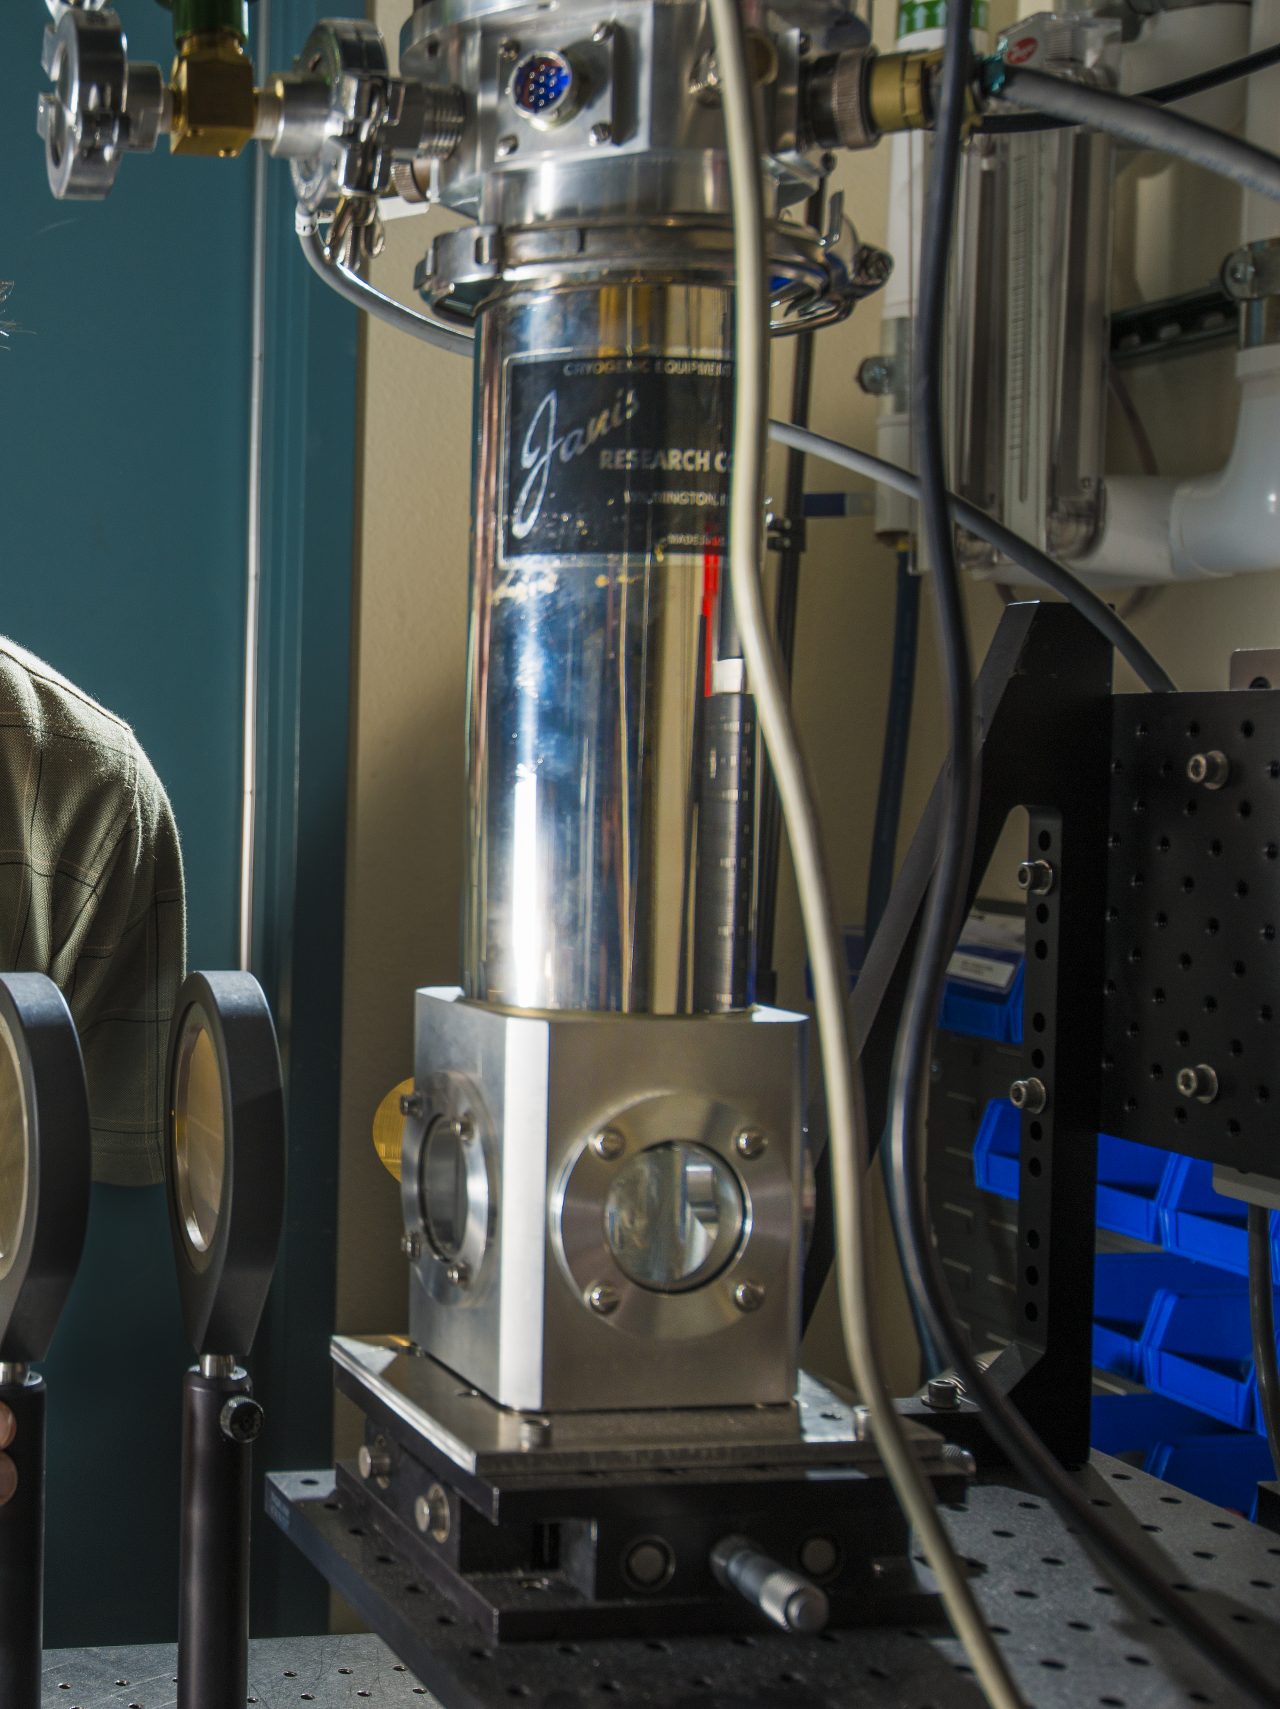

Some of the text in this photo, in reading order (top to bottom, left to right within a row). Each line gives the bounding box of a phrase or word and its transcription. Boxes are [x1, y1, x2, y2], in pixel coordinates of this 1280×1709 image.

[512, 389, 640, 539] Janis
[600, 449, 731, 474] RESEARCH C
